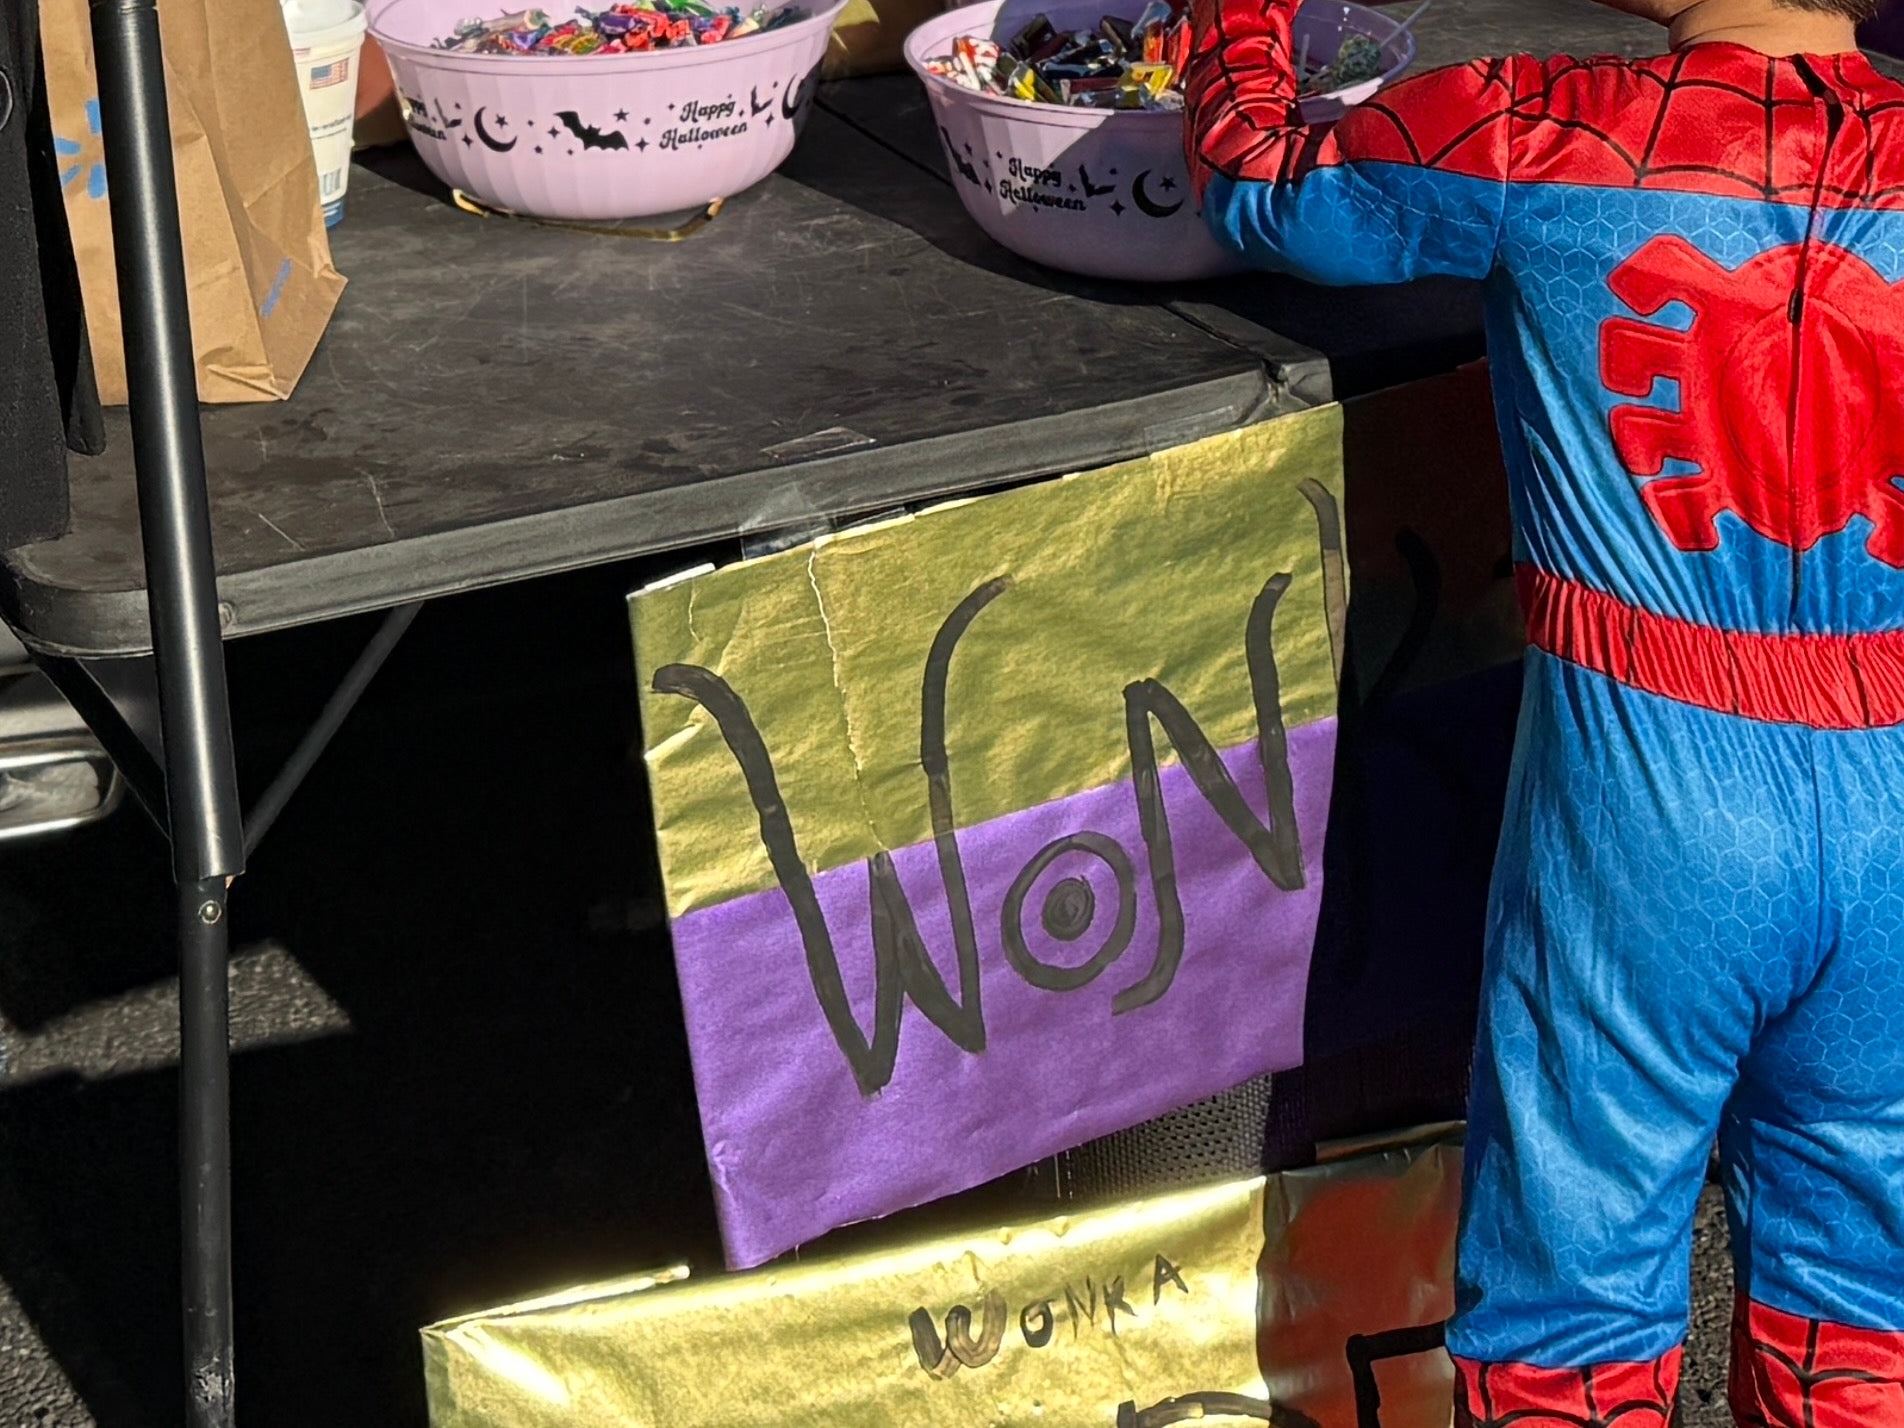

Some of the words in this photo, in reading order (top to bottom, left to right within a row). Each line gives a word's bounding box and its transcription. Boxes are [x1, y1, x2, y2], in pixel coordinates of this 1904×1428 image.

[679, 99, 737, 124] Happy
[658, 121, 748, 151] Halloween
[1008, 157, 1062, 187] Happy
[999, 179, 1086, 211] Halloween
